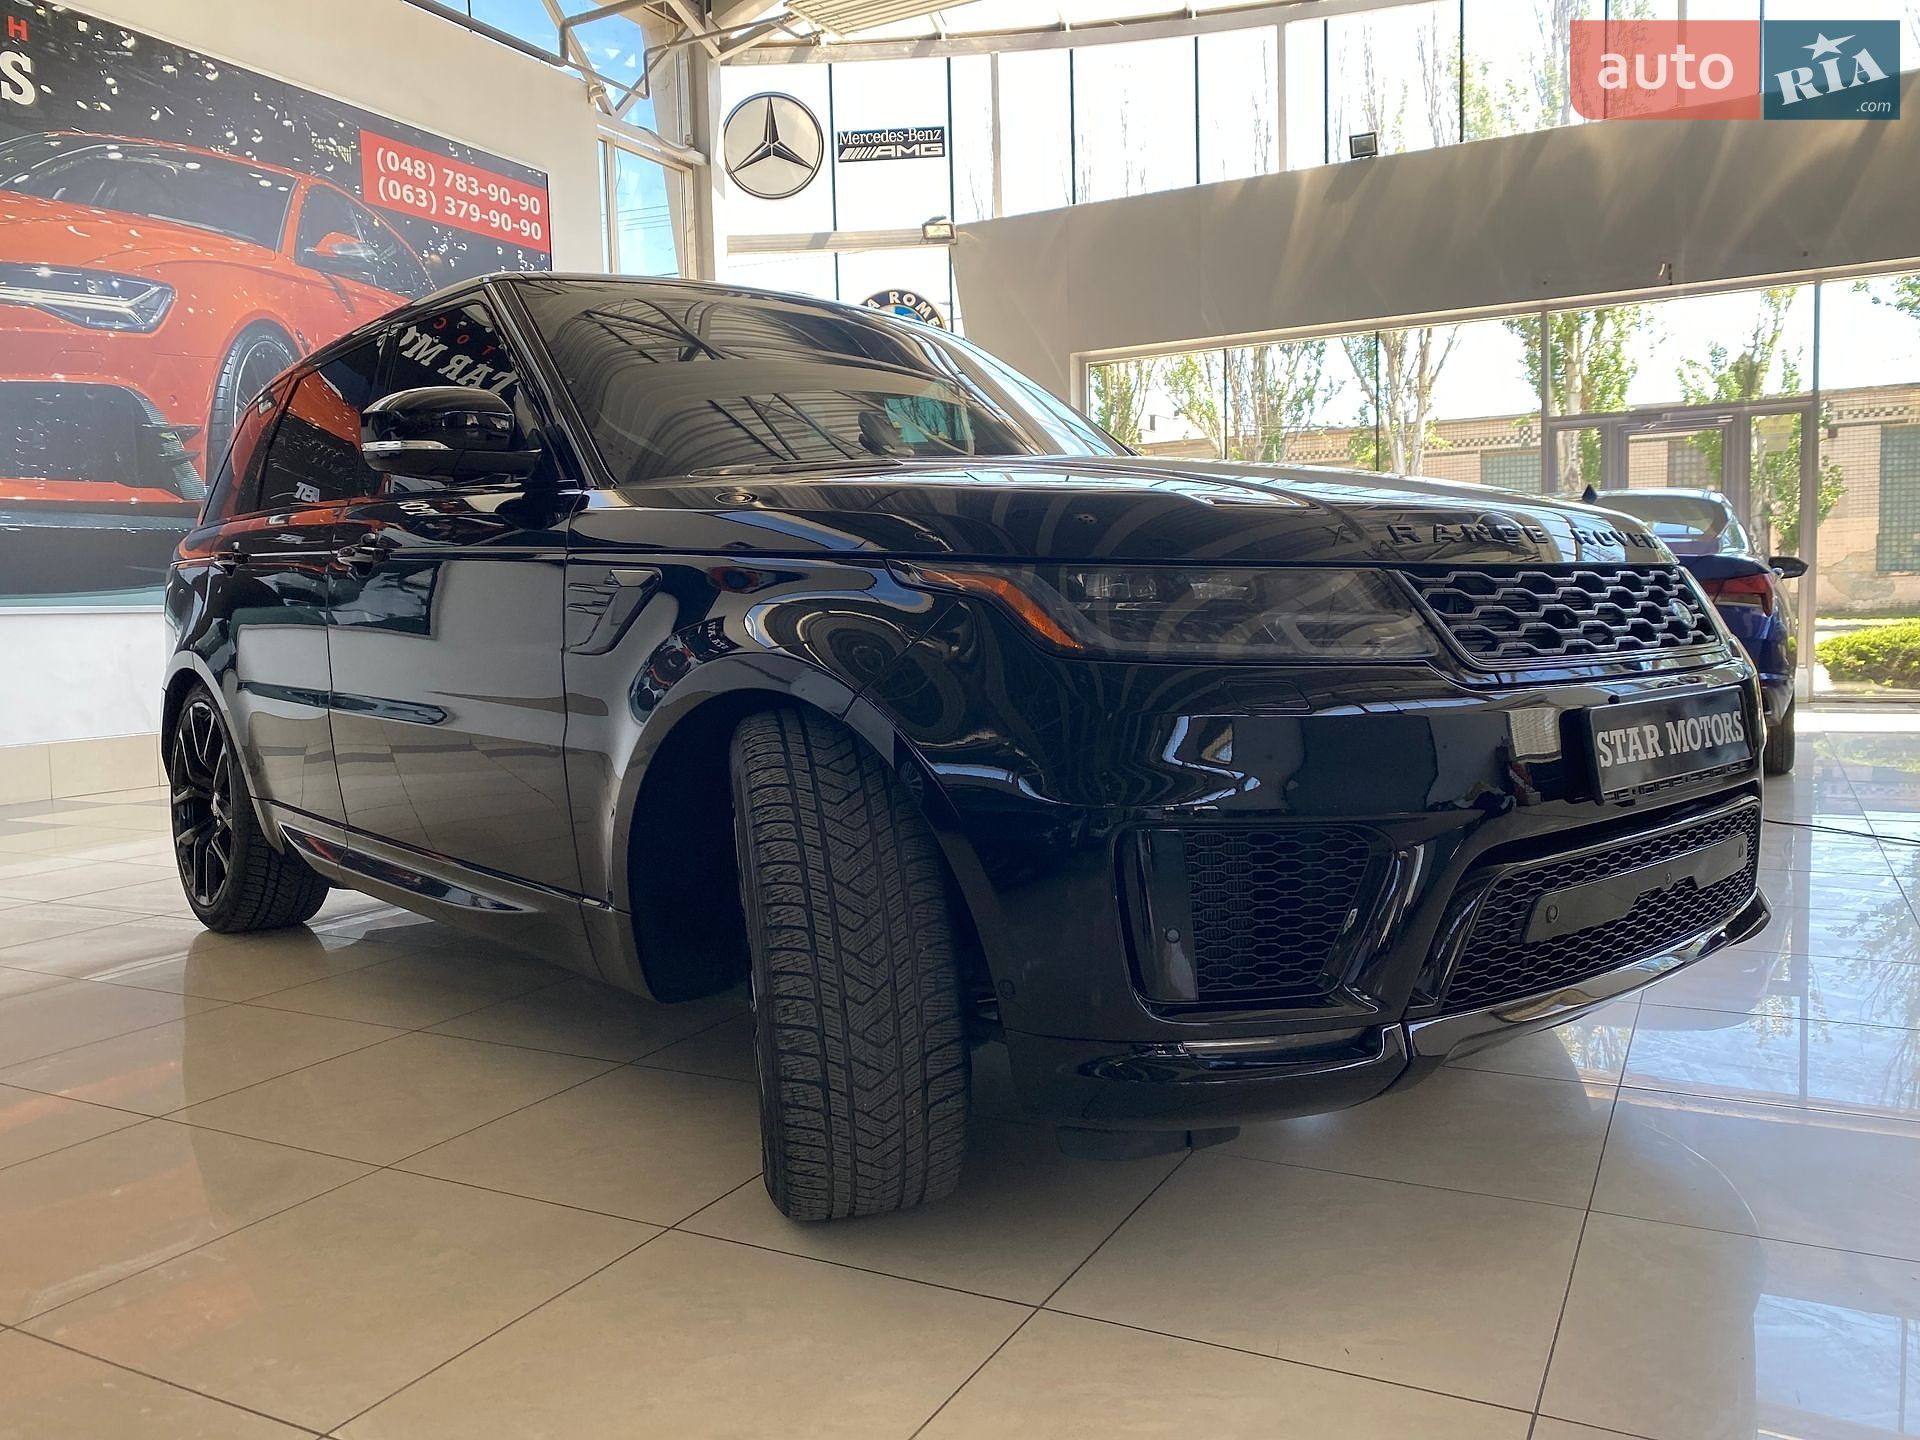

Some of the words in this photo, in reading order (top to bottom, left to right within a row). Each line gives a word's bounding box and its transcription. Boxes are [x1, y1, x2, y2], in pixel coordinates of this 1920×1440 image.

[839, 128, 942, 146] Mercedes-Benz
[871, 143, 943, 158] AMG
[376, 148, 436, 187] (048)
[442, 168, 541, 216] 783-90-90
[378, 176, 437, 215] (063)
[444, 196, 542, 240] 379-90-90
[1386, 523, 1549, 545] RANGE
[1596, 724, 1664, 768] STAR
[1665, 710, 1745, 755] MOTORS
